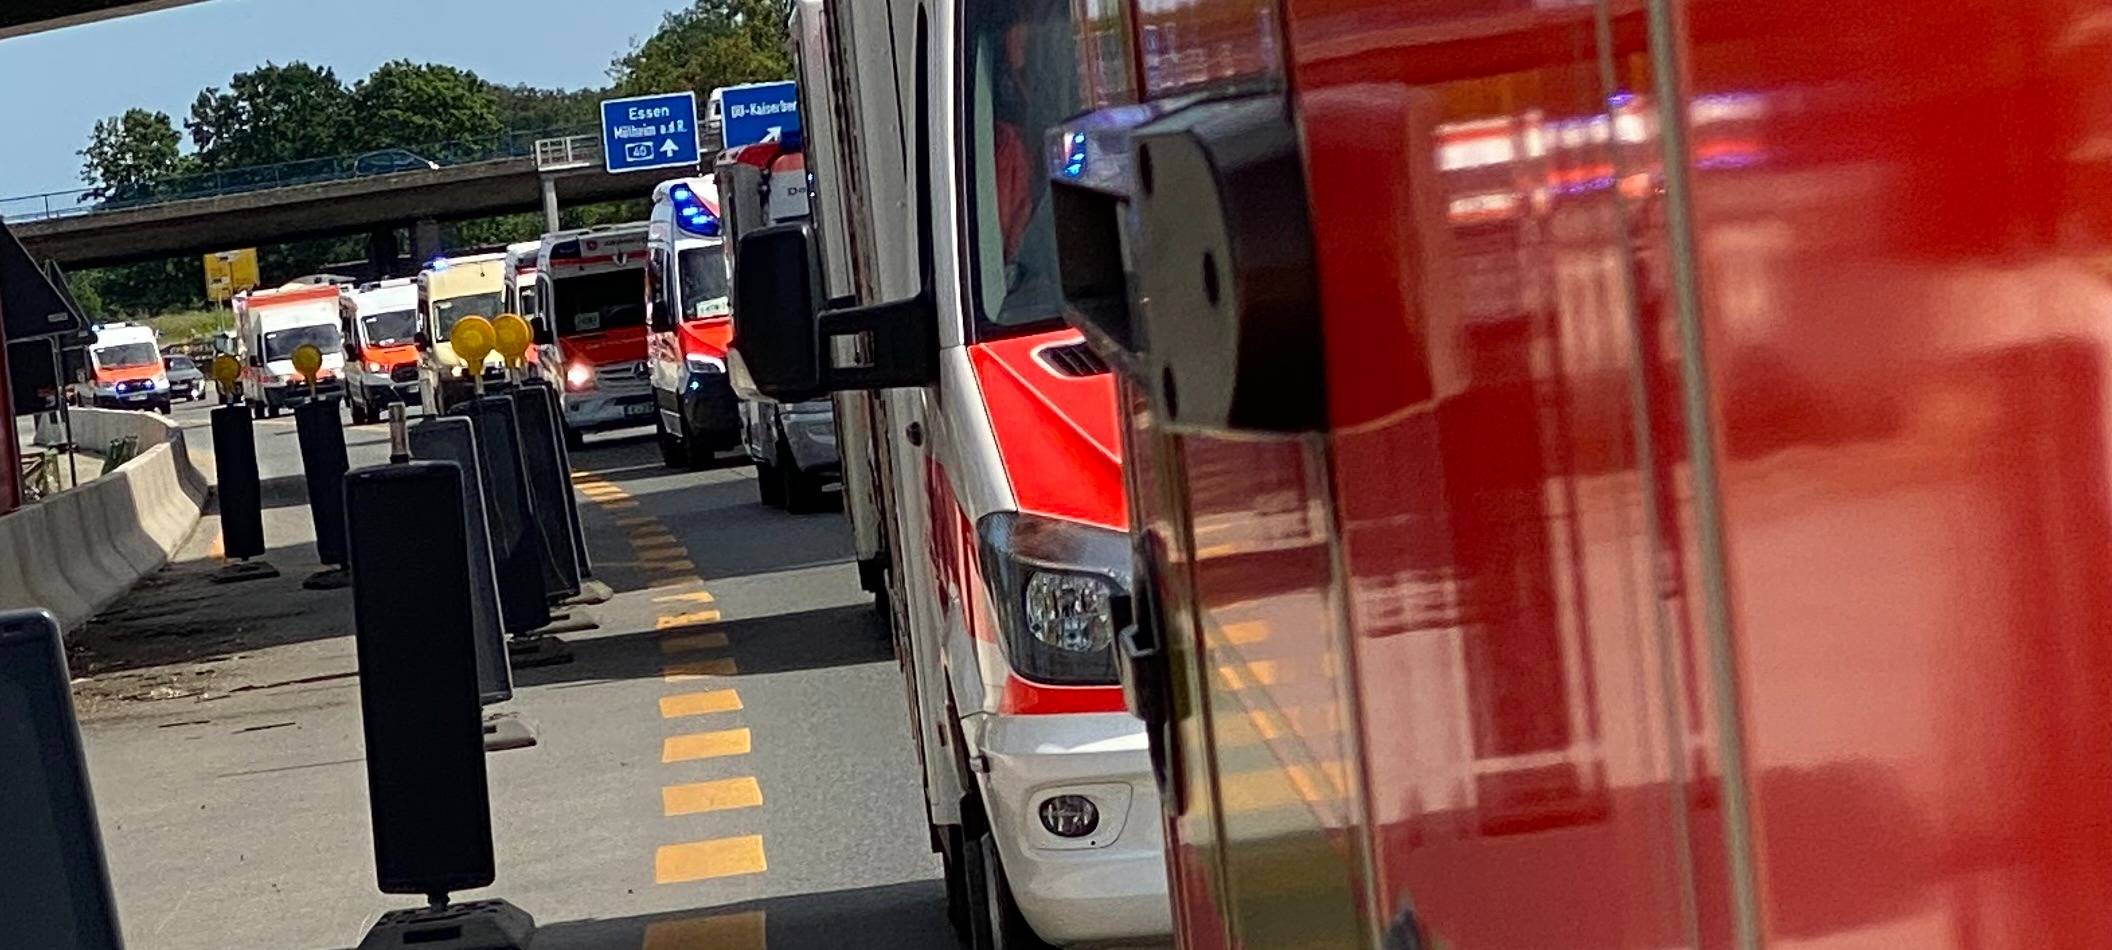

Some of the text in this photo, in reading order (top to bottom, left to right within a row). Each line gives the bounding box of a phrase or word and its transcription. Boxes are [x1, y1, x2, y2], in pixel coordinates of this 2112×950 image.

[629, 107, 670, 120] Essen
[614, 123, 657, 139] Mülheim
[633, 145, 648, 156] 40
